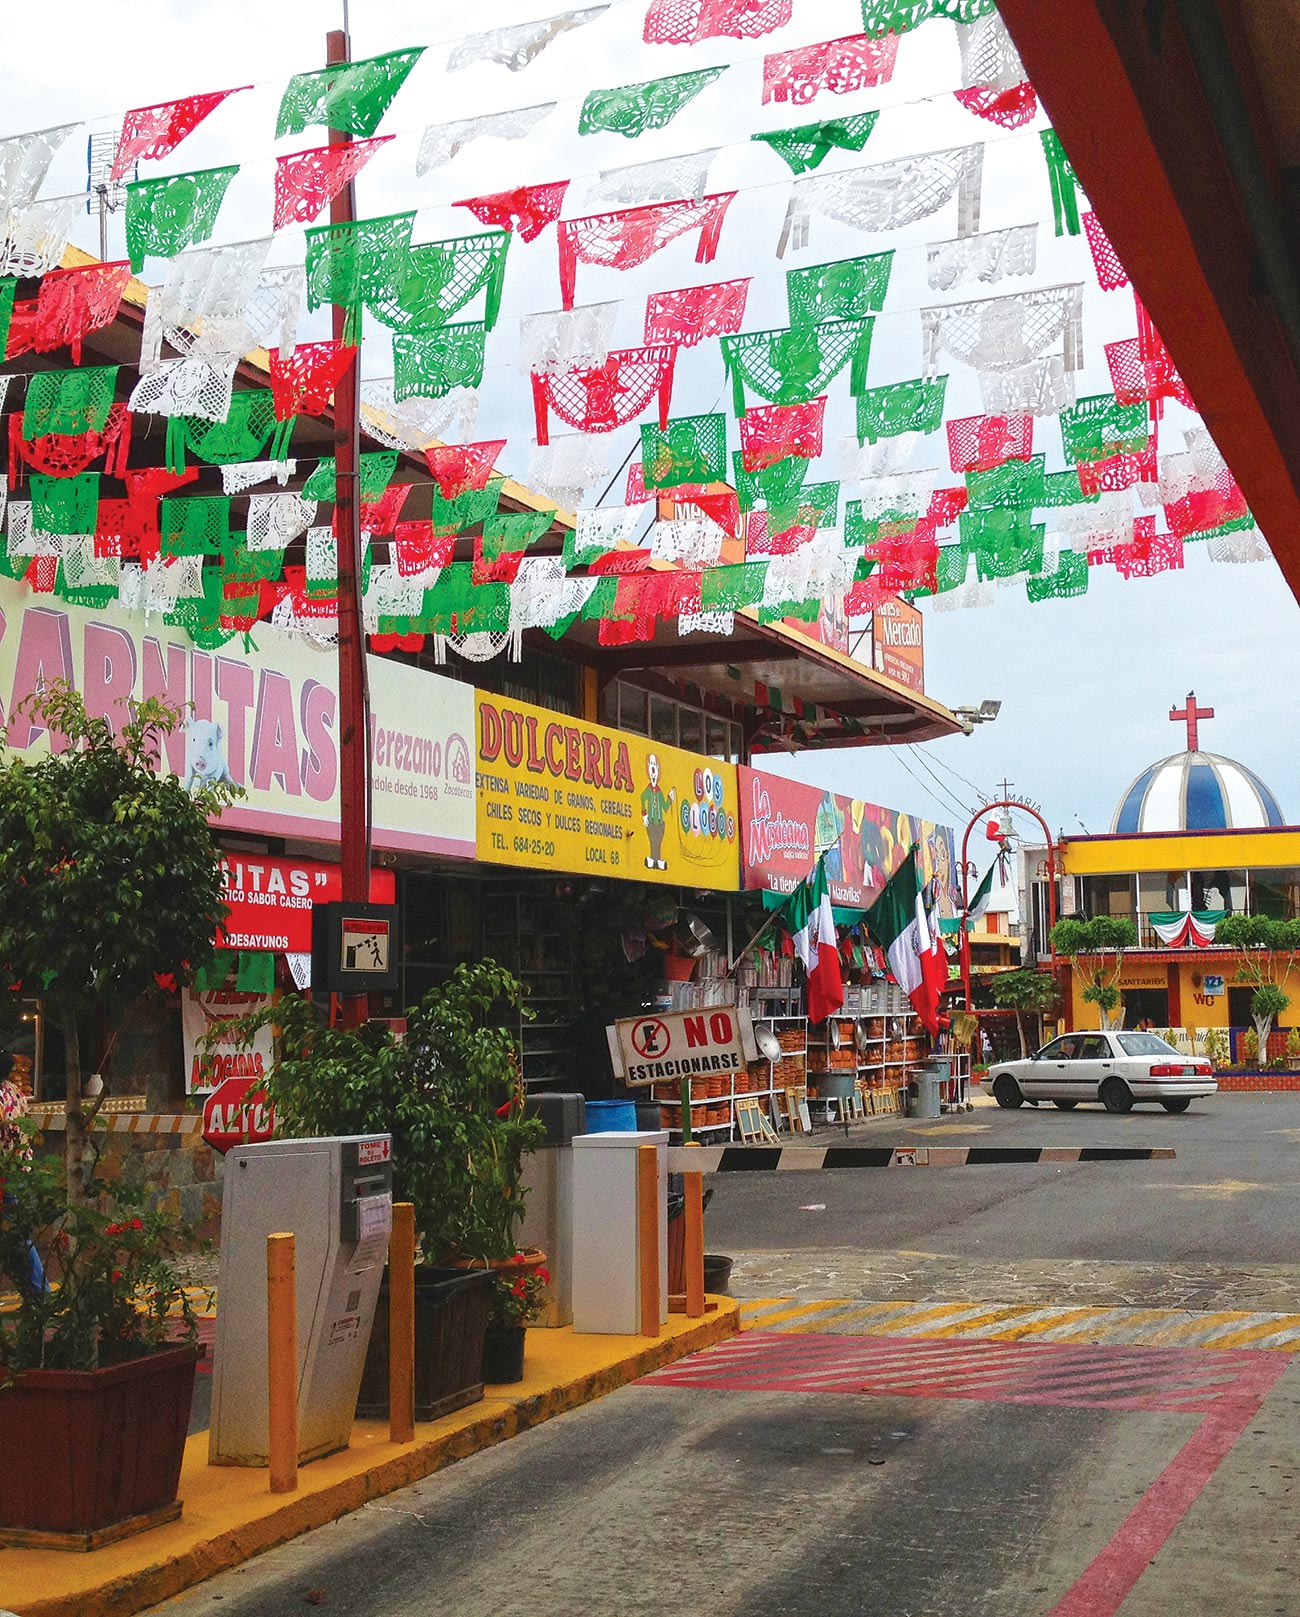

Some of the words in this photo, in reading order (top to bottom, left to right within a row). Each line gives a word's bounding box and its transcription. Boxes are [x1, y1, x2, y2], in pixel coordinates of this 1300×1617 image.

[883, 617, 922, 647] Mercado
[0, 605, 337, 803] ARNITAS
[479, 703, 635, 794] DULCERIA
[394, 779, 418, 798] desde
[420, 784, 439, 801] 1968
[475, 771, 510, 795] EXTENSA
[514, 781, 549, 802] VARIEDAD
[554, 789, 564, 806] DE
[567, 792, 597, 813] GRANOS,
[600, 799, 633, 819] CEREALES
[694, 772, 722, 804] LOS
[752, 777, 772, 822] La
[1007, 793, 1043, 815] MARIA
[486, 801, 513, 821] CHILES
[518, 807, 542, 827] SECOS
[546, 813, 552, 828] Y
[555, 814, 581, 832] DULCES
[585, 820, 623, 840] REGIONALES
[681, 804, 734, 838] GLOBOS
[491, 832, 509, 851] TEL.
[749, 811, 810, 868] Mexicana
[585, 846, 607, 864] LOCAL
[610, 851, 620, 865] 68
[247, 891, 277, 906] SABOR
[279, 895, 313, 910] CASERO
[230, 933, 289, 949] DESAYUNOS
[1118, 977, 1166, 986] SANITARIOS
[1193, 993, 1215, 1007] WC
[684, 1012, 733, 1048] NO
[628, 1052, 739, 1081] ESTACIONARSE
[208, 1103, 270, 1133] ALTO
[359, 1142, 382, 1150] TOME
